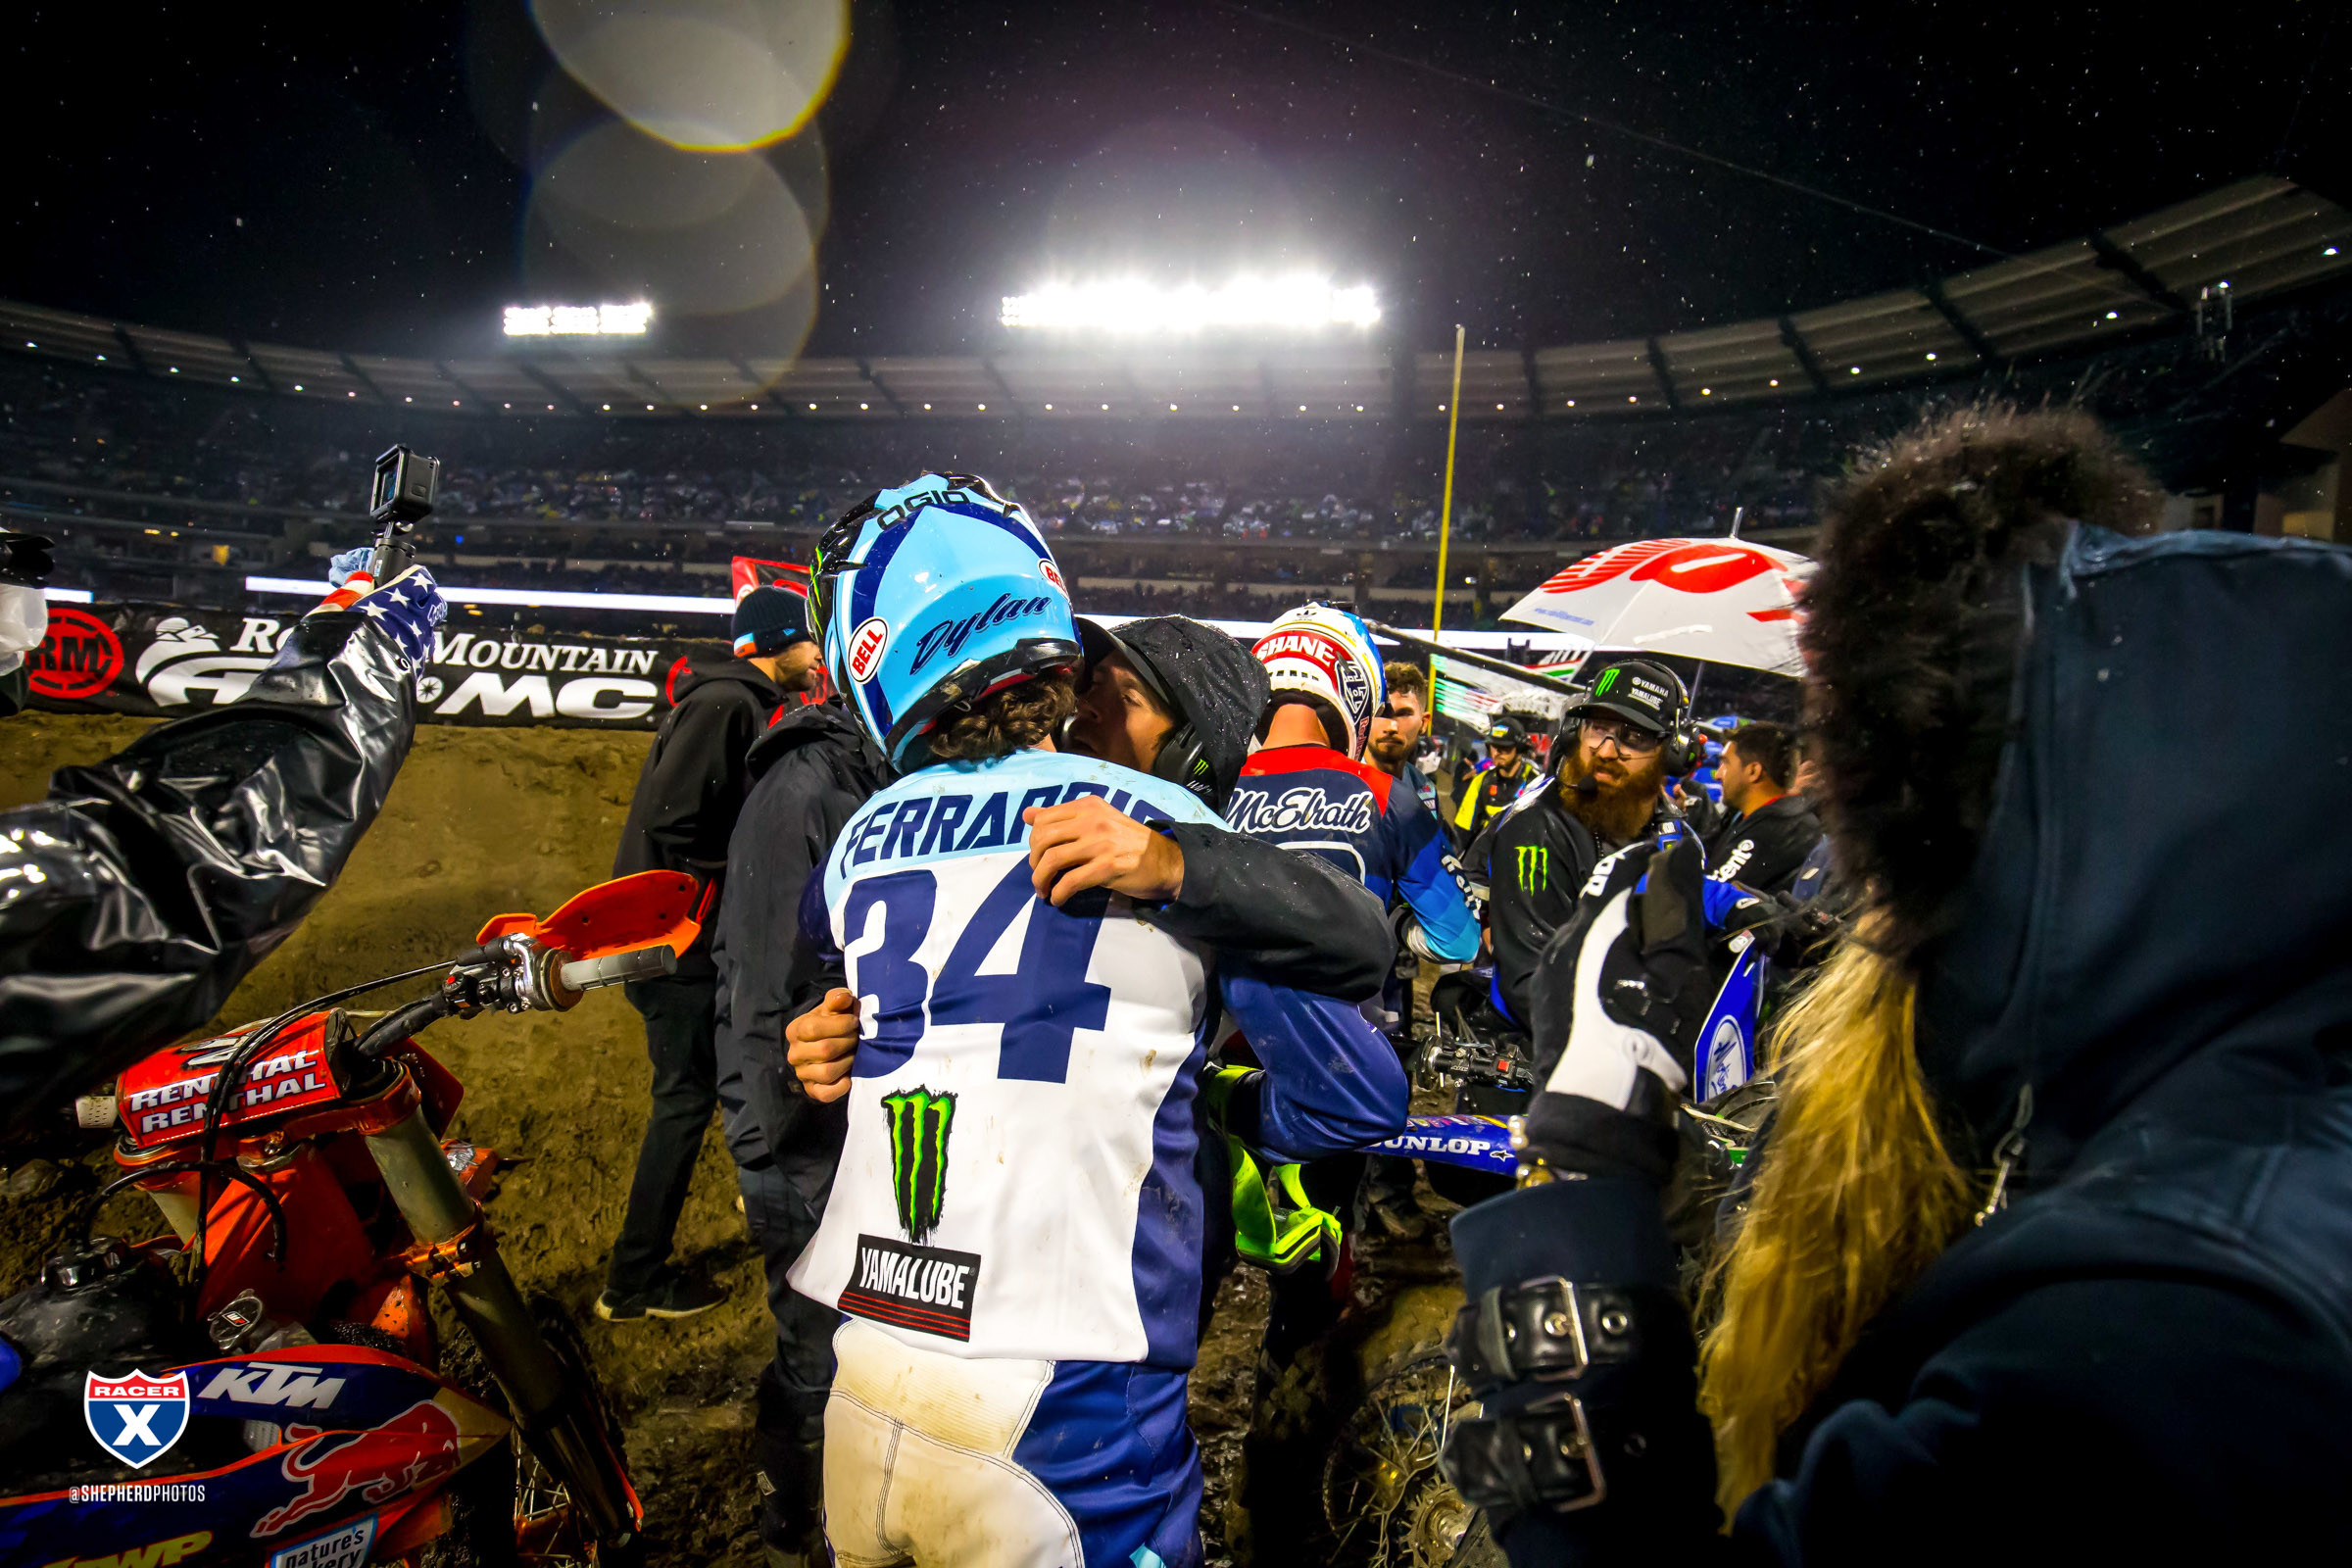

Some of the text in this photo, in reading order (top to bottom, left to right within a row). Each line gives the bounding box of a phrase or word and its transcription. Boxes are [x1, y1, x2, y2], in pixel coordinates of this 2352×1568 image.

[876, 490, 970, 531] OGIO
[852, 629, 883, 676] BELL
[908, 592, 1053, 675] Dylan
[1255, 635, 1336, 667] SHANE
[1630, 687, 1664, 707] YAMALUBE
[1640, 679, 1670, 699] YAMAHA
[1225, 787, 1374, 833] McElrath
[844, 868, 1112, 1084] 34
[858, 1247, 970, 1310] YAMALUBE
[197, 1361, 346, 1409] KTM
